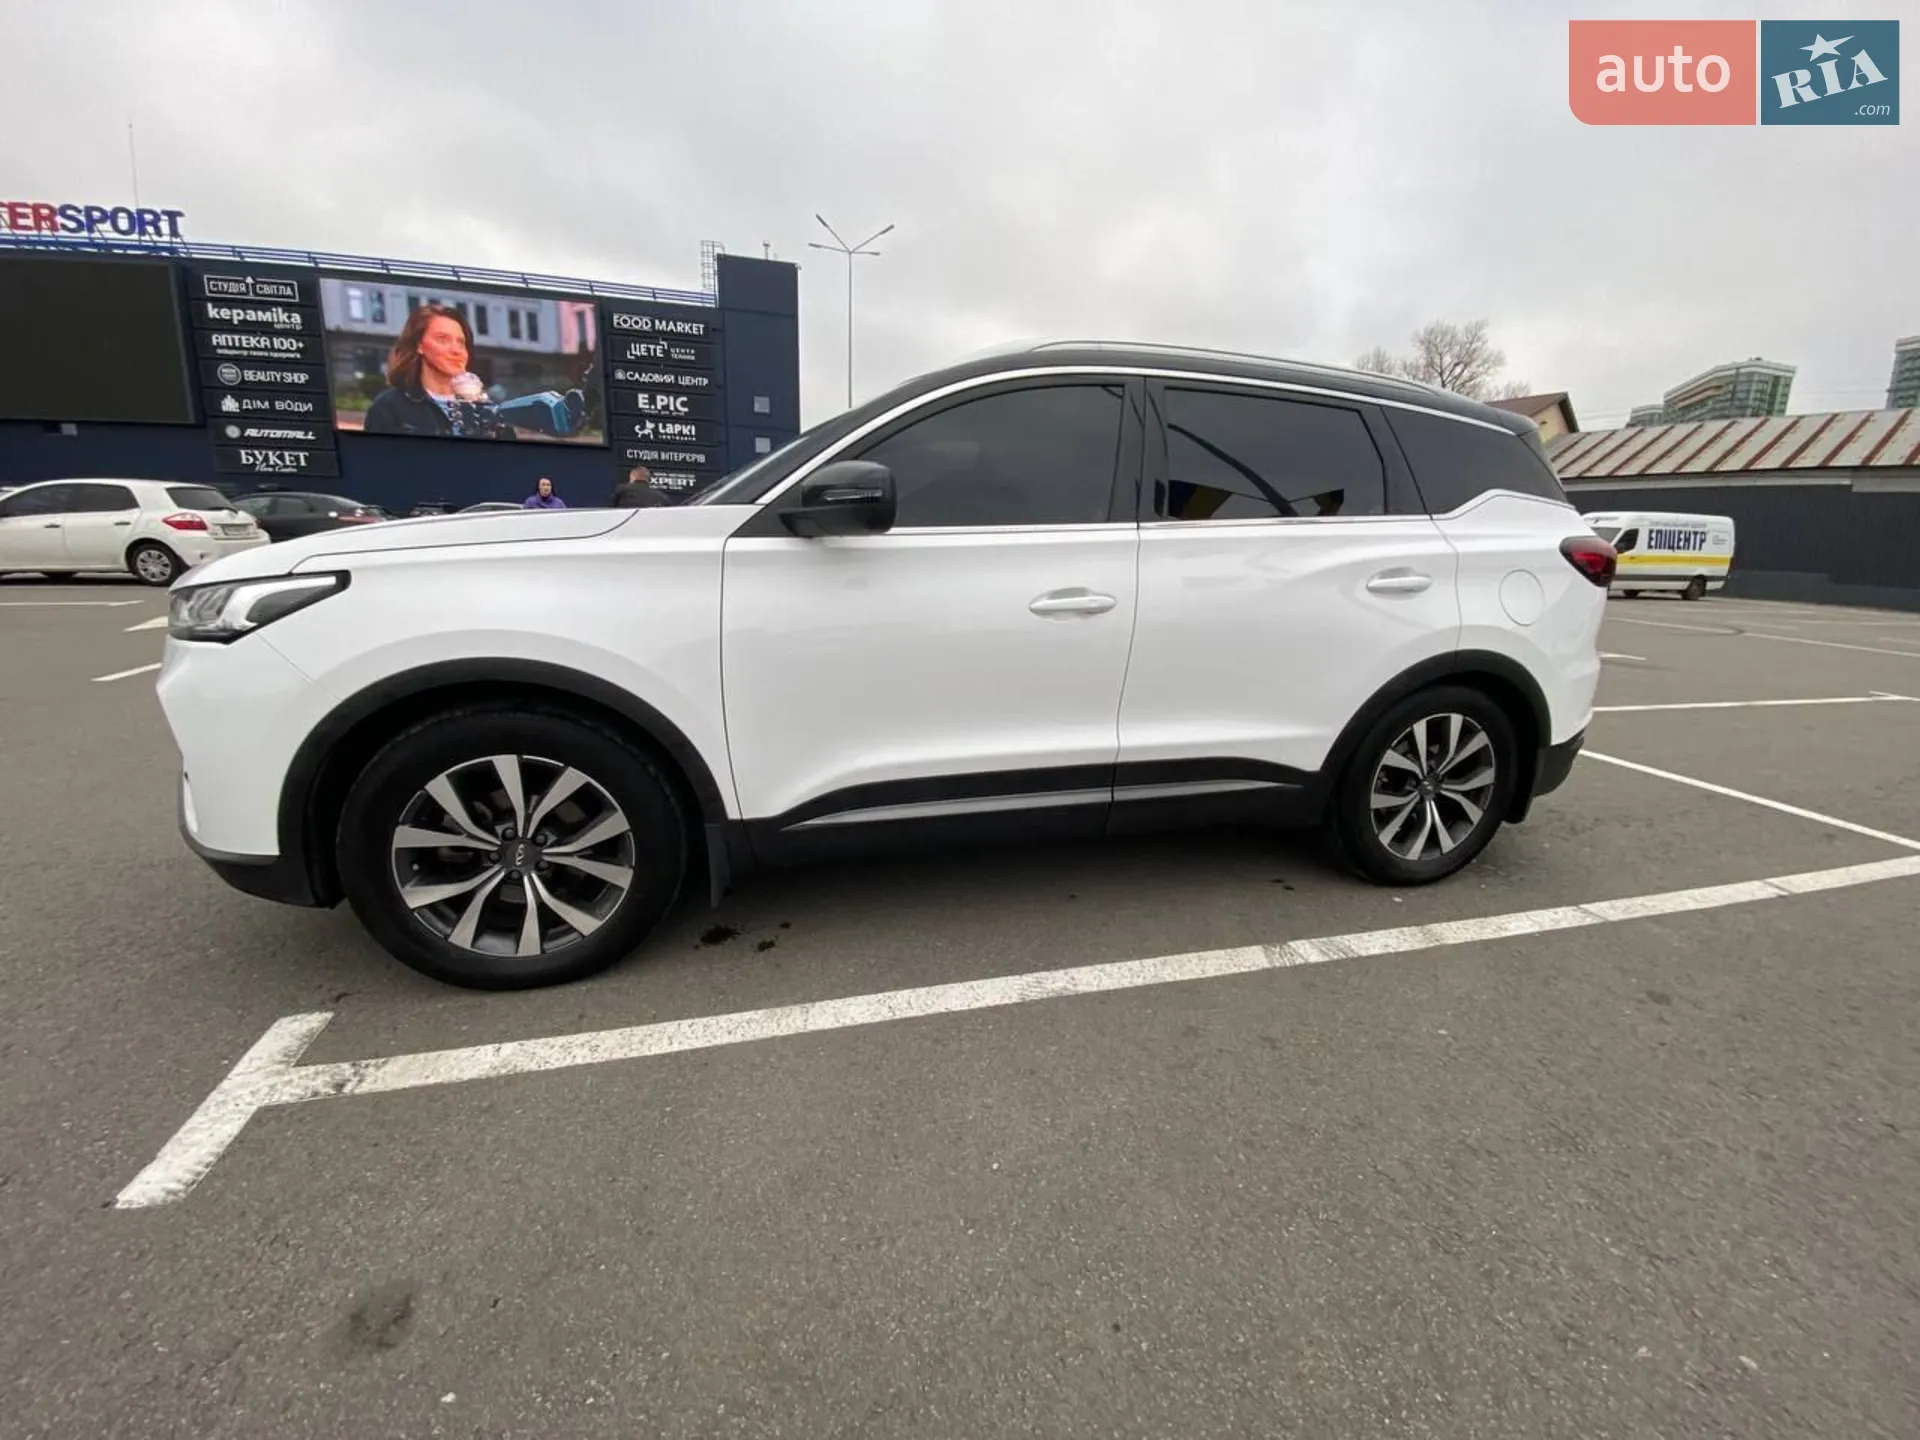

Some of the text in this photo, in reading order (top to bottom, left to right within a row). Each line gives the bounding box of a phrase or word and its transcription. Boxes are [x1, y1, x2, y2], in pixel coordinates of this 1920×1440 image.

[0, 201, 185, 239] ERSPORT
[209, 281, 294, 296] СТУДІЯ СВІТЛА
[613, 313, 705, 335] FOOD MARKET
[212, 334, 304, 351] АПТЕКА 100+
[243, 369, 281, 382] BEAUTY
[283, 372, 309, 384] SHOP
[626, 370, 709, 387] САДОВИЙ ЦЕНТР
[242, 399, 313, 412] ДІМ ВОДИ
[637, 393, 689, 413] E.PIC
[240, 449, 309, 467] БУКЕТ
[626, 449, 658, 461] СТУДІЯ
[649, 476, 697, 487] XPERT
[1647, 529, 1707, 552] ЕПІЦЕНТР
